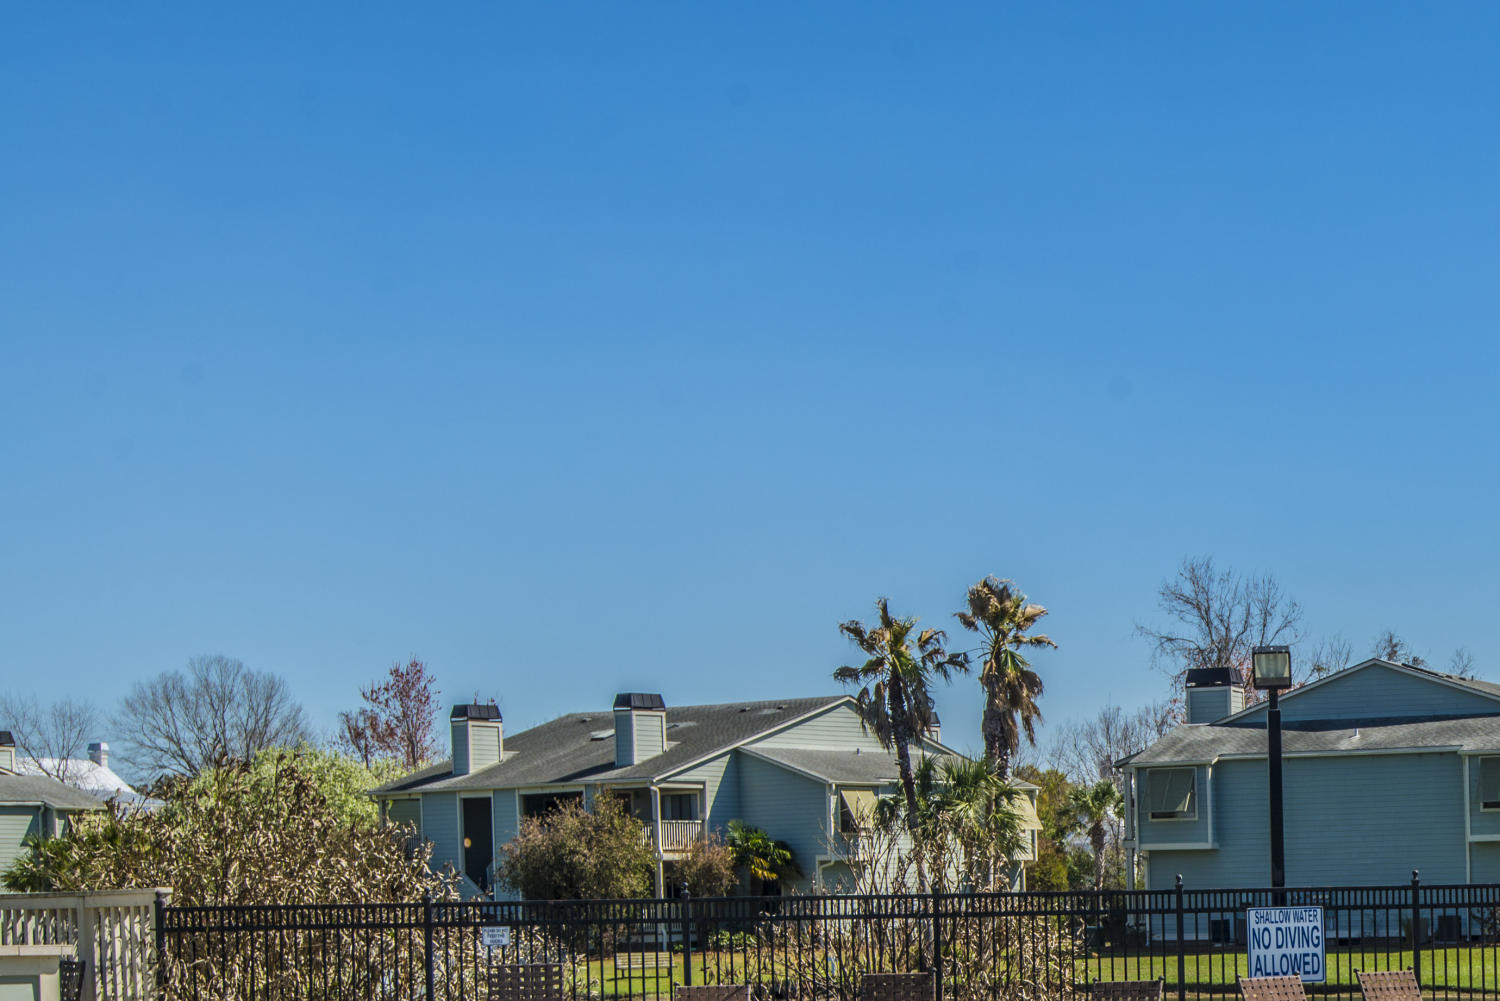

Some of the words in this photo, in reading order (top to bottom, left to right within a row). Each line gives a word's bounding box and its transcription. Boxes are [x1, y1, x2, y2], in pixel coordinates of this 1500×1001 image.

[1255, 910, 1291, 924] SHALLOW
[1292, 909, 1318, 923] WATER
[1252, 927, 1271, 950] NO
[1275, 926, 1320, 949] DIVING
[1254, 953, 1320, 977] ALLOWED
